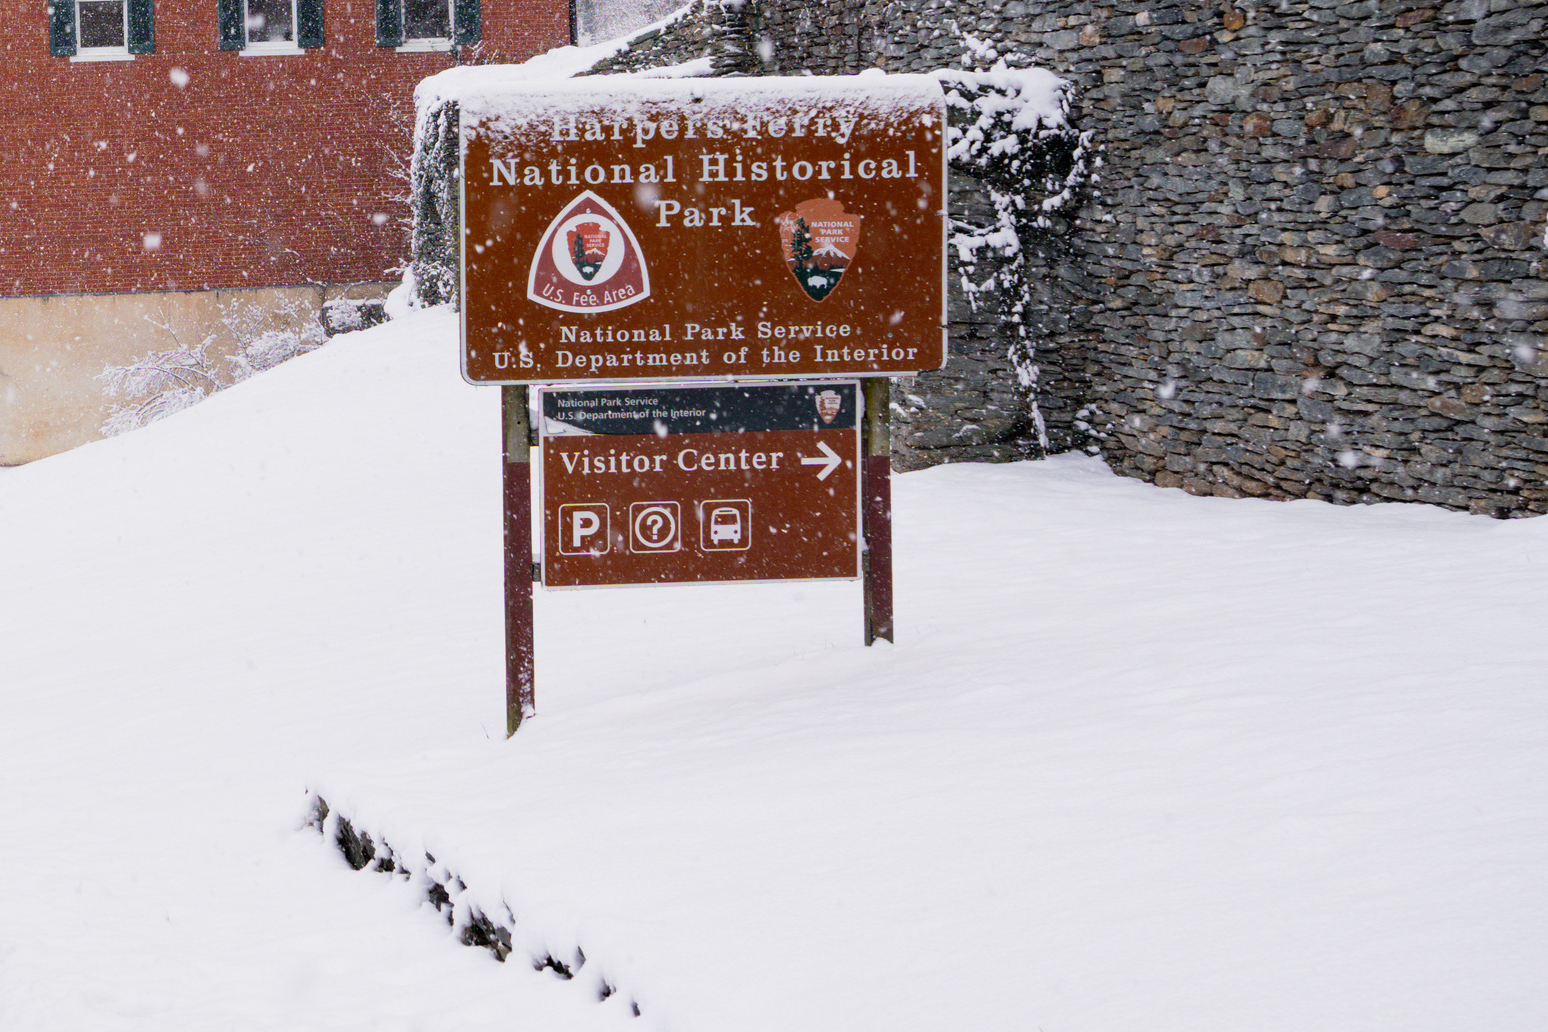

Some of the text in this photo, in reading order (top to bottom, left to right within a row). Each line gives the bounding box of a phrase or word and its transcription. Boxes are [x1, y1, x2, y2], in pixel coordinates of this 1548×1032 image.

[550, 115, 725, 149] Harpers
[489, 150, 919, 186] National Historical
[655, 198, 756, 228] Park
[542, 283, 636, 306] U.S. Fee Area
[559, 320, 852, 343] National Park Service
[492, 344, 919, 372] U.S. Department of the Interior
[557, 396, 659, 408] National Park Service
[557, 408, 707, 421] U.S. Department of the Interior
[559, 448, 784, 474] Visitor Center
[572, 511, 600, 547] P
